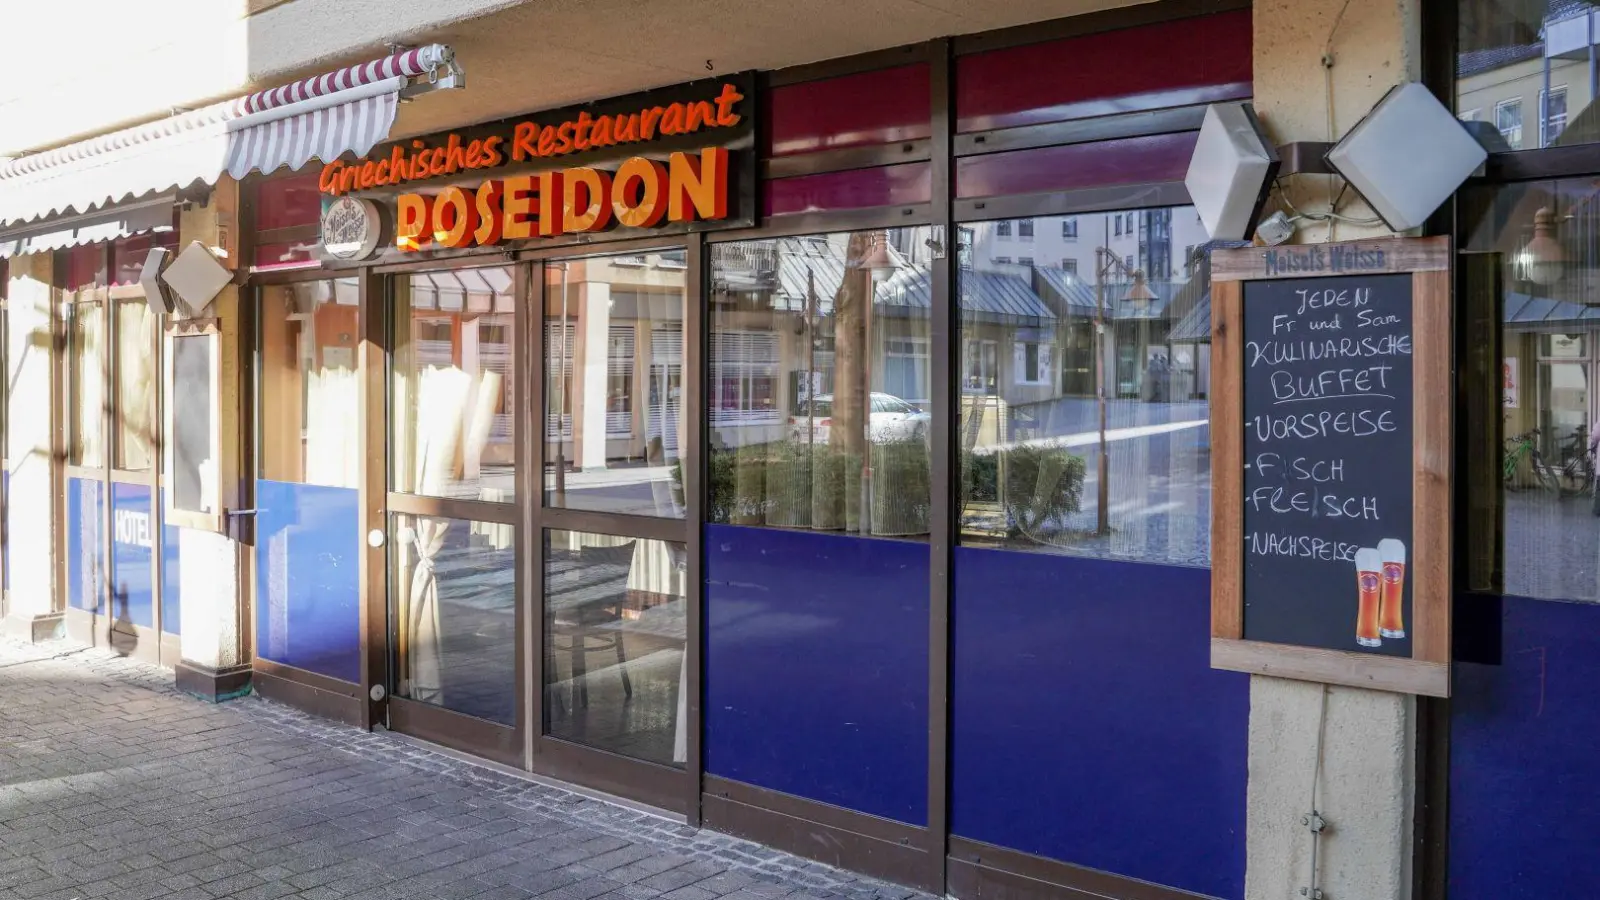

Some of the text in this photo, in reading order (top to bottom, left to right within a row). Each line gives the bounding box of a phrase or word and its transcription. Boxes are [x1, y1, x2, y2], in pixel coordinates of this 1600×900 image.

[319, 84, 745, 195] Griechisches Restaurant
[397, 147, 729, 251] POSEIDON
[1329, 246, 1386, 272] Weisse
[1295, 287, 1371, 315] JEDEN
[1272, 309, 1401, 336] Fr und Sam
[1246, 334, 1412, 368] KULINARISCHE
[1270, 362, 1393, 400] BUFFET
[115, 508, 152, 548] HOTEL
